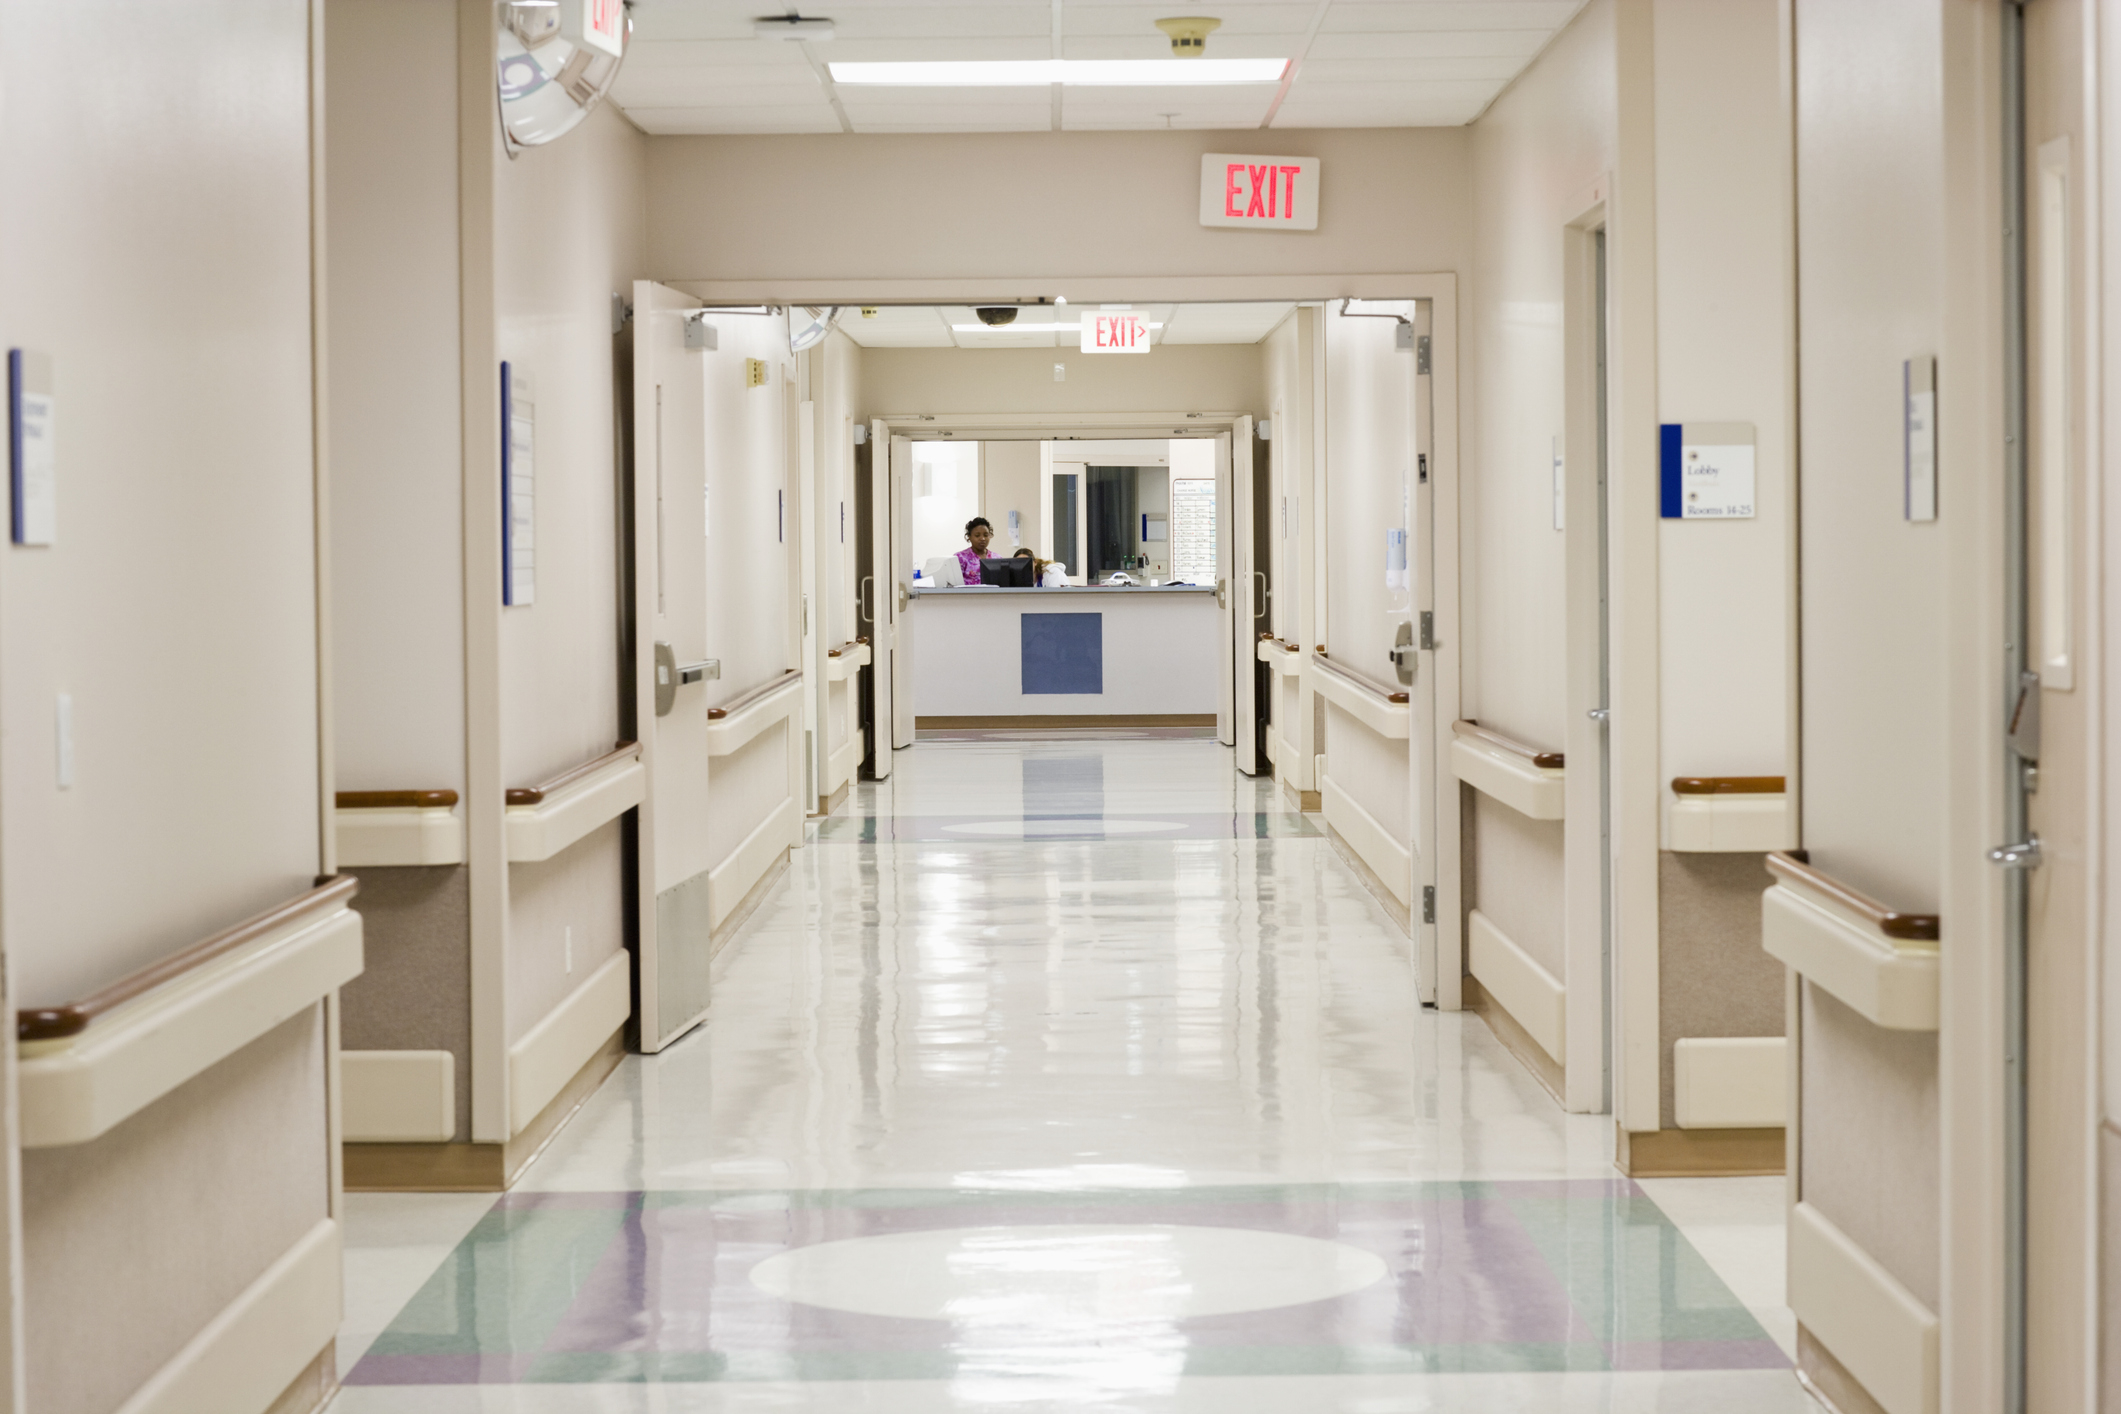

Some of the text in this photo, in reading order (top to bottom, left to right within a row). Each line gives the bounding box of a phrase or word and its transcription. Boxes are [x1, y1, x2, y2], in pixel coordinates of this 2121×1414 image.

[1225, 163, 1301, 219] EXIT
[1096, 316, 1139, 347] EXIT
[1687, 465, 1720, 477] Lobby
[1687, 505, 1752, 515] Rooms 14-25
